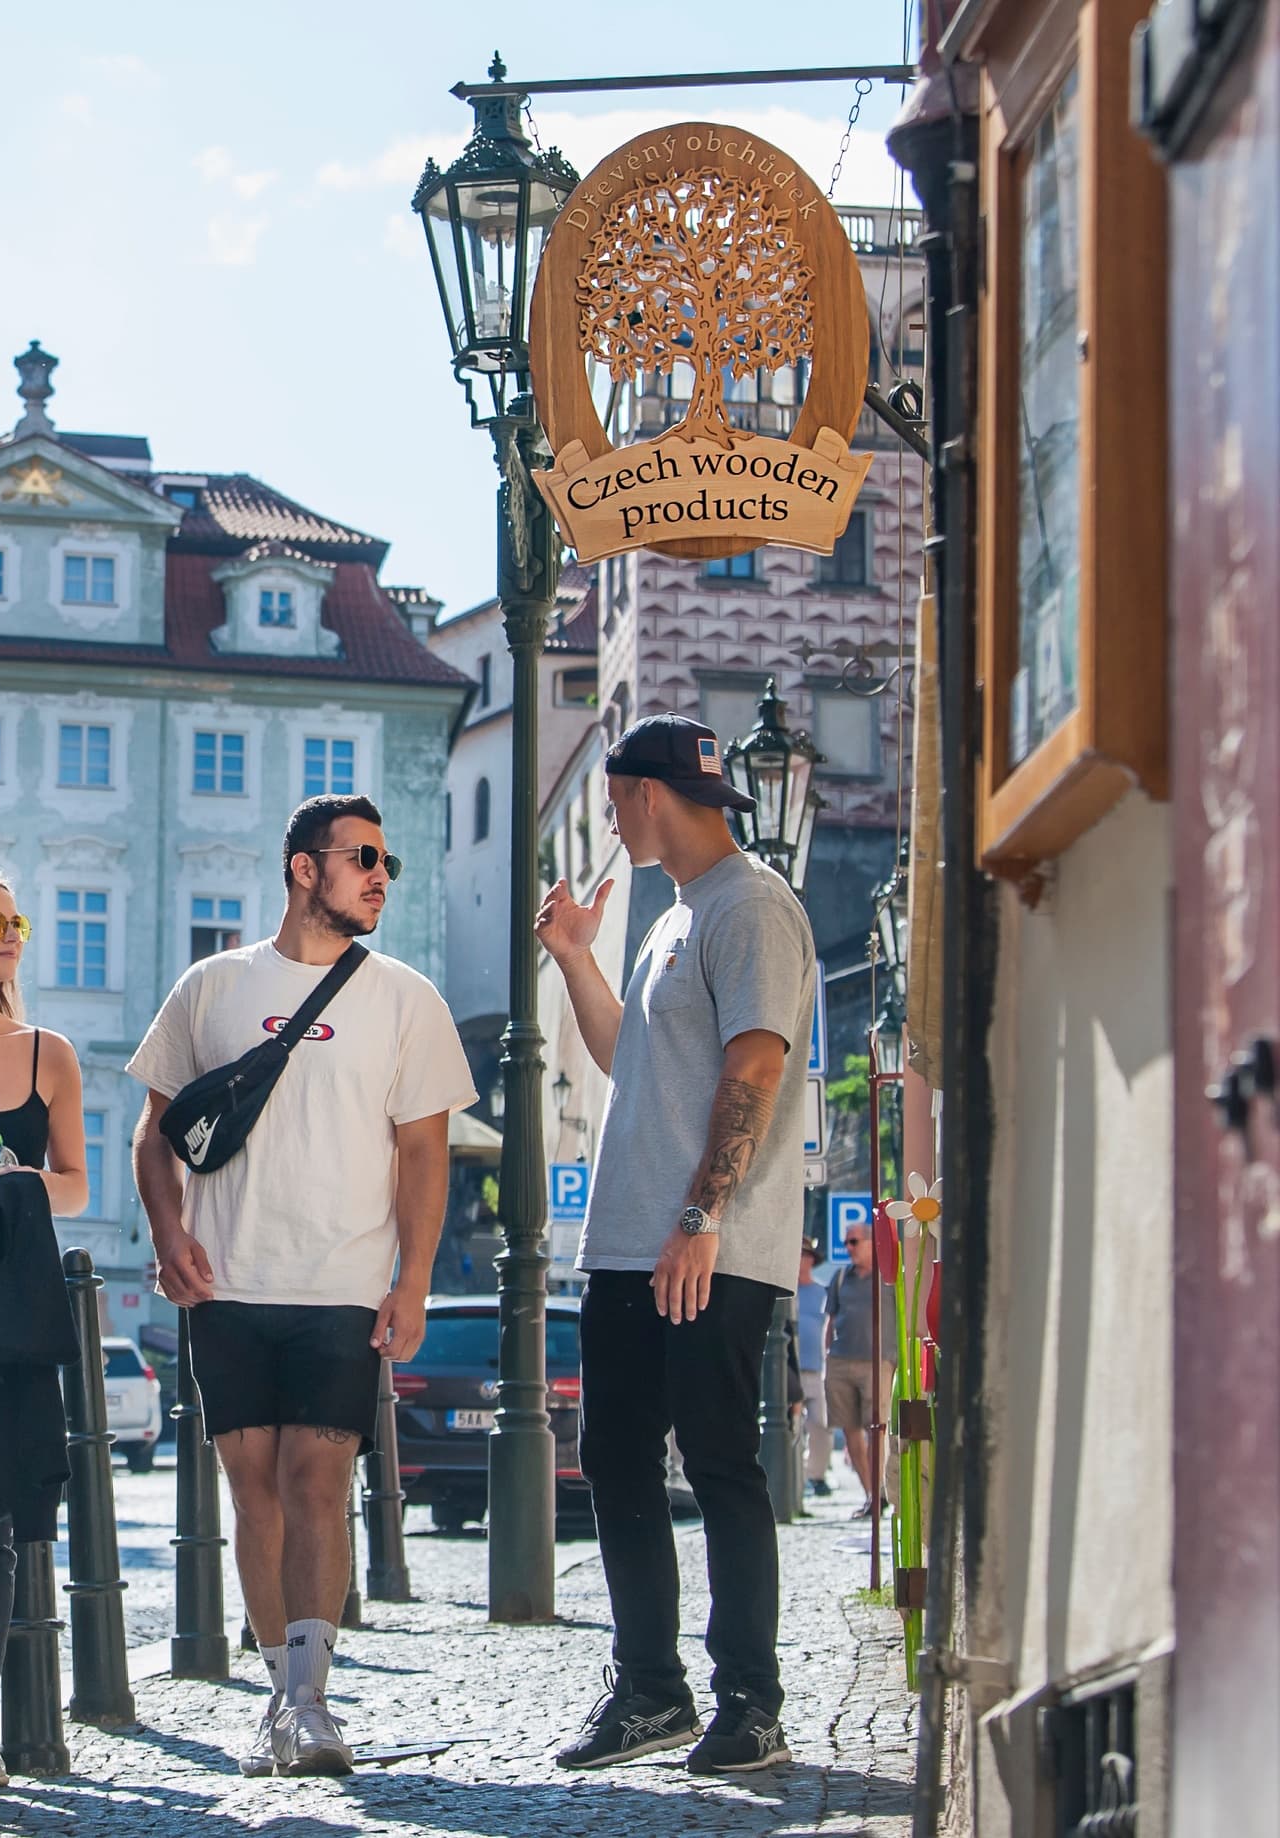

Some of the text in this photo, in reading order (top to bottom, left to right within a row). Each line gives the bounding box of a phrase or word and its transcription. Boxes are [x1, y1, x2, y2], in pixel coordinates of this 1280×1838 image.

[565, 134, 819, 232] Dřevěný obchůdek
[567, 450, 842, 511] Czech wooden
[619, 490, 789, 538] products
[184, 1116, 209, 1152] NIKE
[557, 1169, 582, 1204] P
[839, 1202, 867, 1242] P
